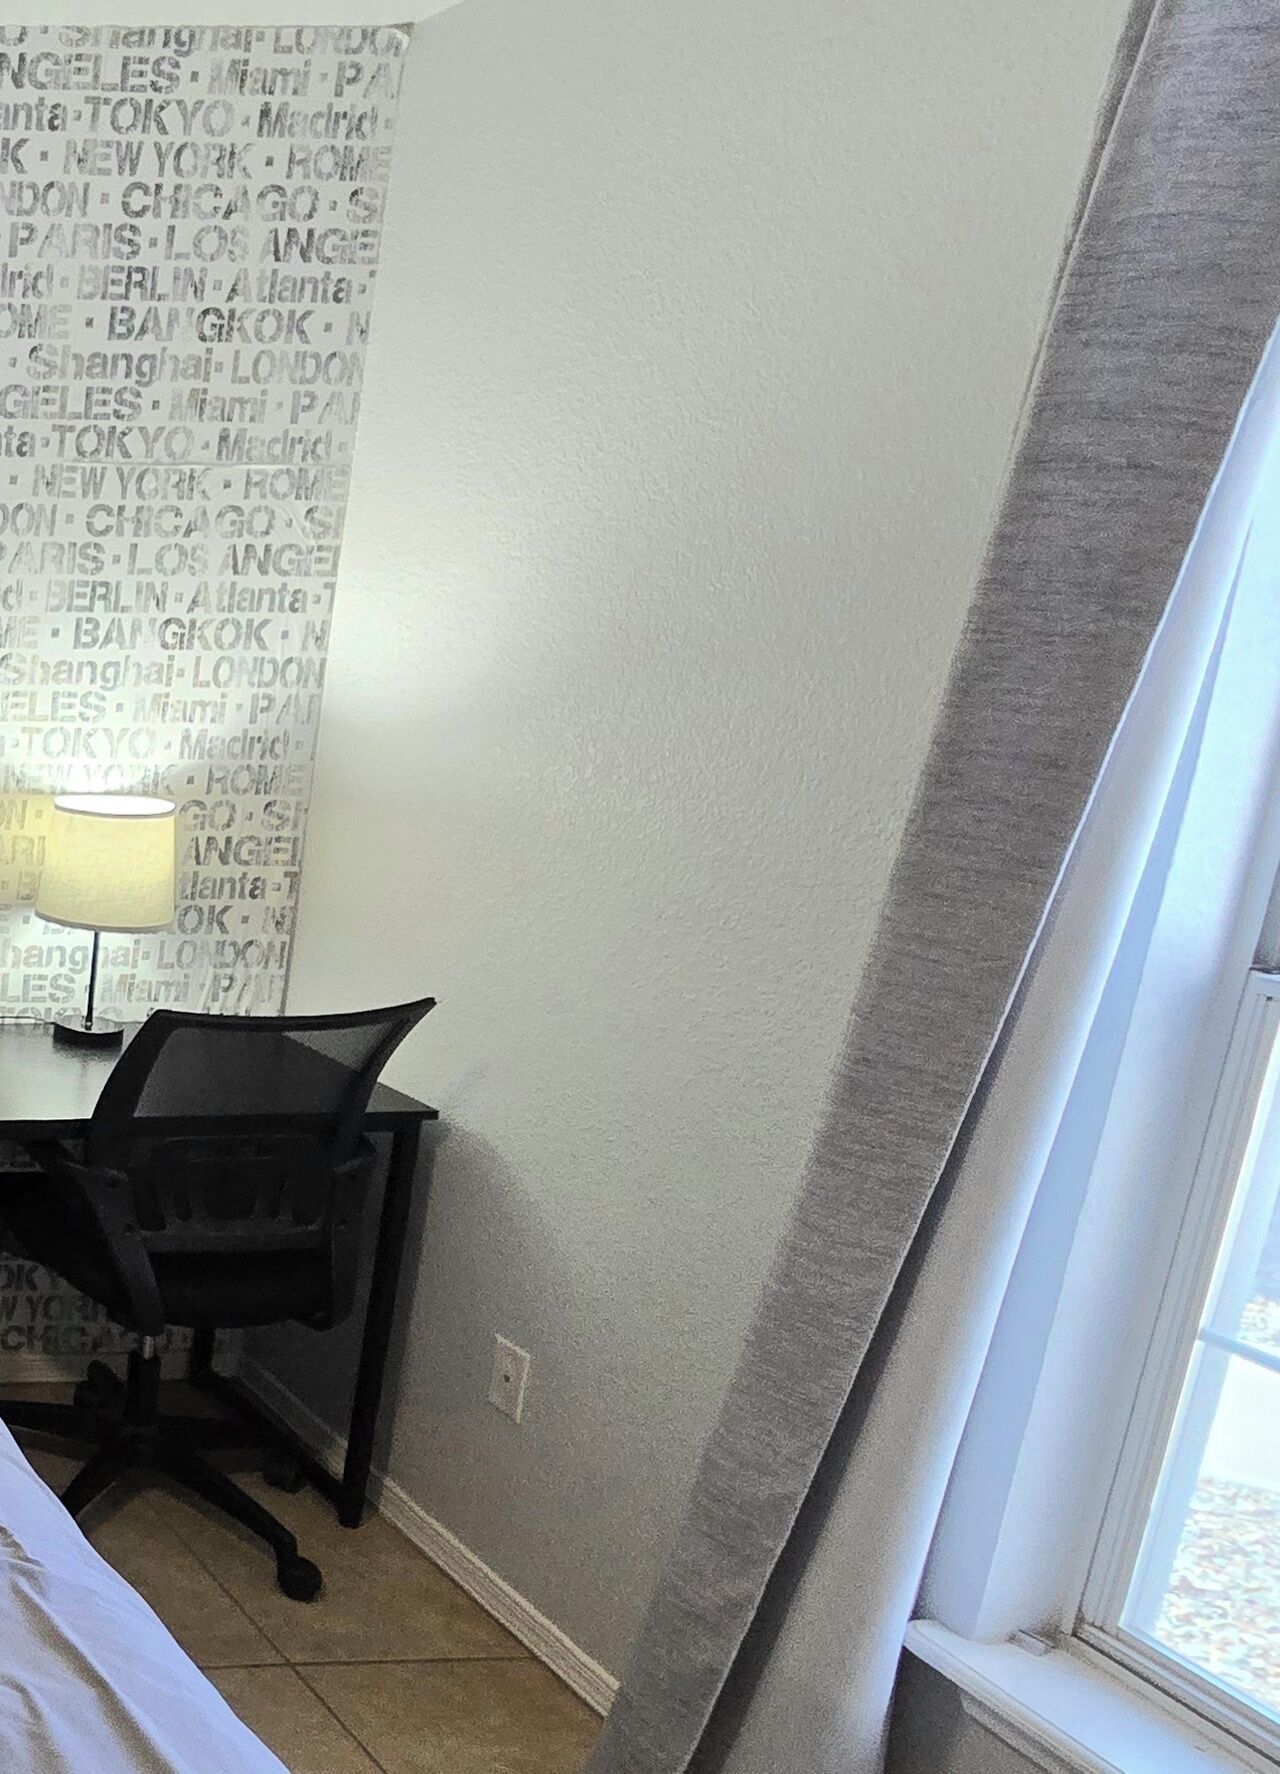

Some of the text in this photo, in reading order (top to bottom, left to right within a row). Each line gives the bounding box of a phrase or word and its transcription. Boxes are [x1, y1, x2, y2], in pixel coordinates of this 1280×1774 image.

[209, 58, 311, 96] Miami
[84, 96, 237, 135] TOKYO
[256, 102, 379, 139] Madrid
[121, 182, 322, 221] CHICAGO
[107, 306, 315, 343] BANGKOK
[26, 347, 218, 390] Shanghai
[51, 424, 196, 459] TOKYO
[216, 428, 333, 465] Madrid
[85, 504, 277, 538] CHICAGO
[127, 542, 210, 576] LOS
[73, 617, 272, 651] BANGKOK
[192, 656, 327, 689] LONDON
[21, 726, 158, 758] TOKYO
[179, 728, 290, 761] Madrid
